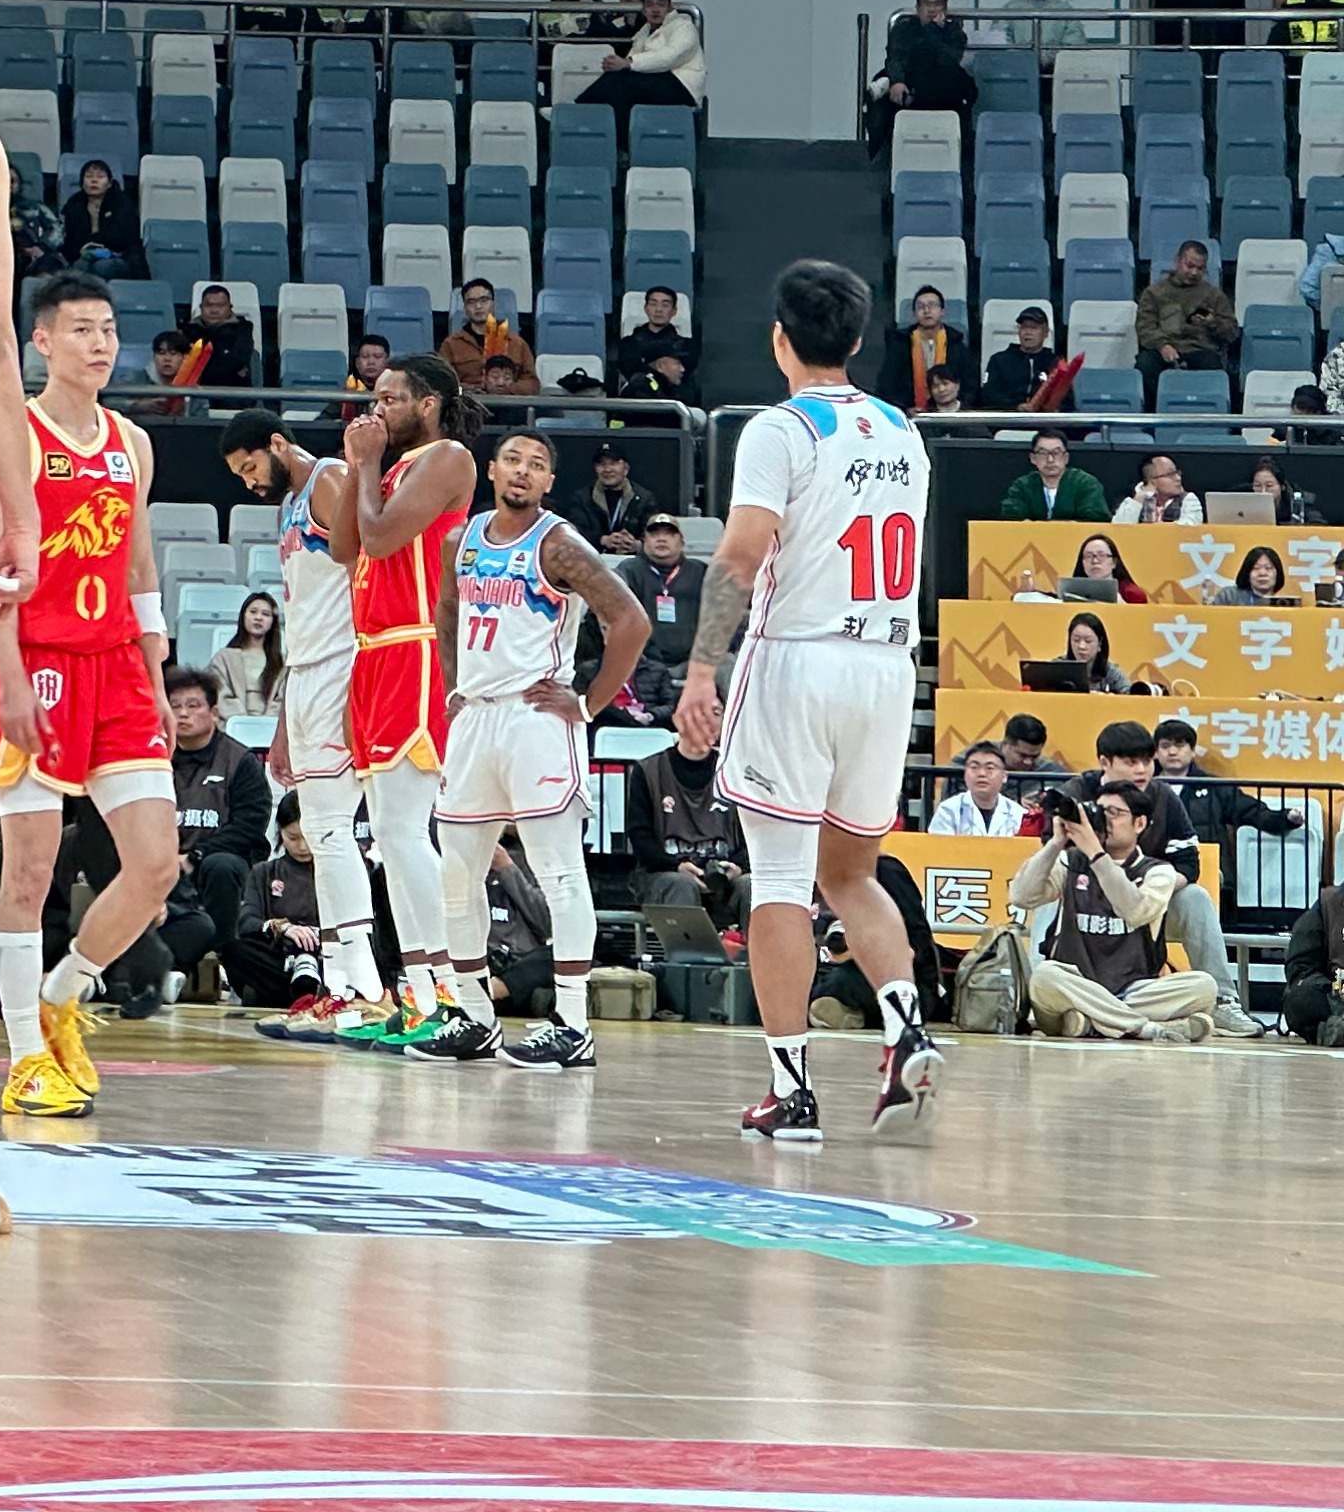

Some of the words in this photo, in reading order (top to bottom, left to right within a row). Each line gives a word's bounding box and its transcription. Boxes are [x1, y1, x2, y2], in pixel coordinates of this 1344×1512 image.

[837, 512, 916, 602] 10
[75, 574, 107, 620] 0
[467, 615, 499, 651] 77
